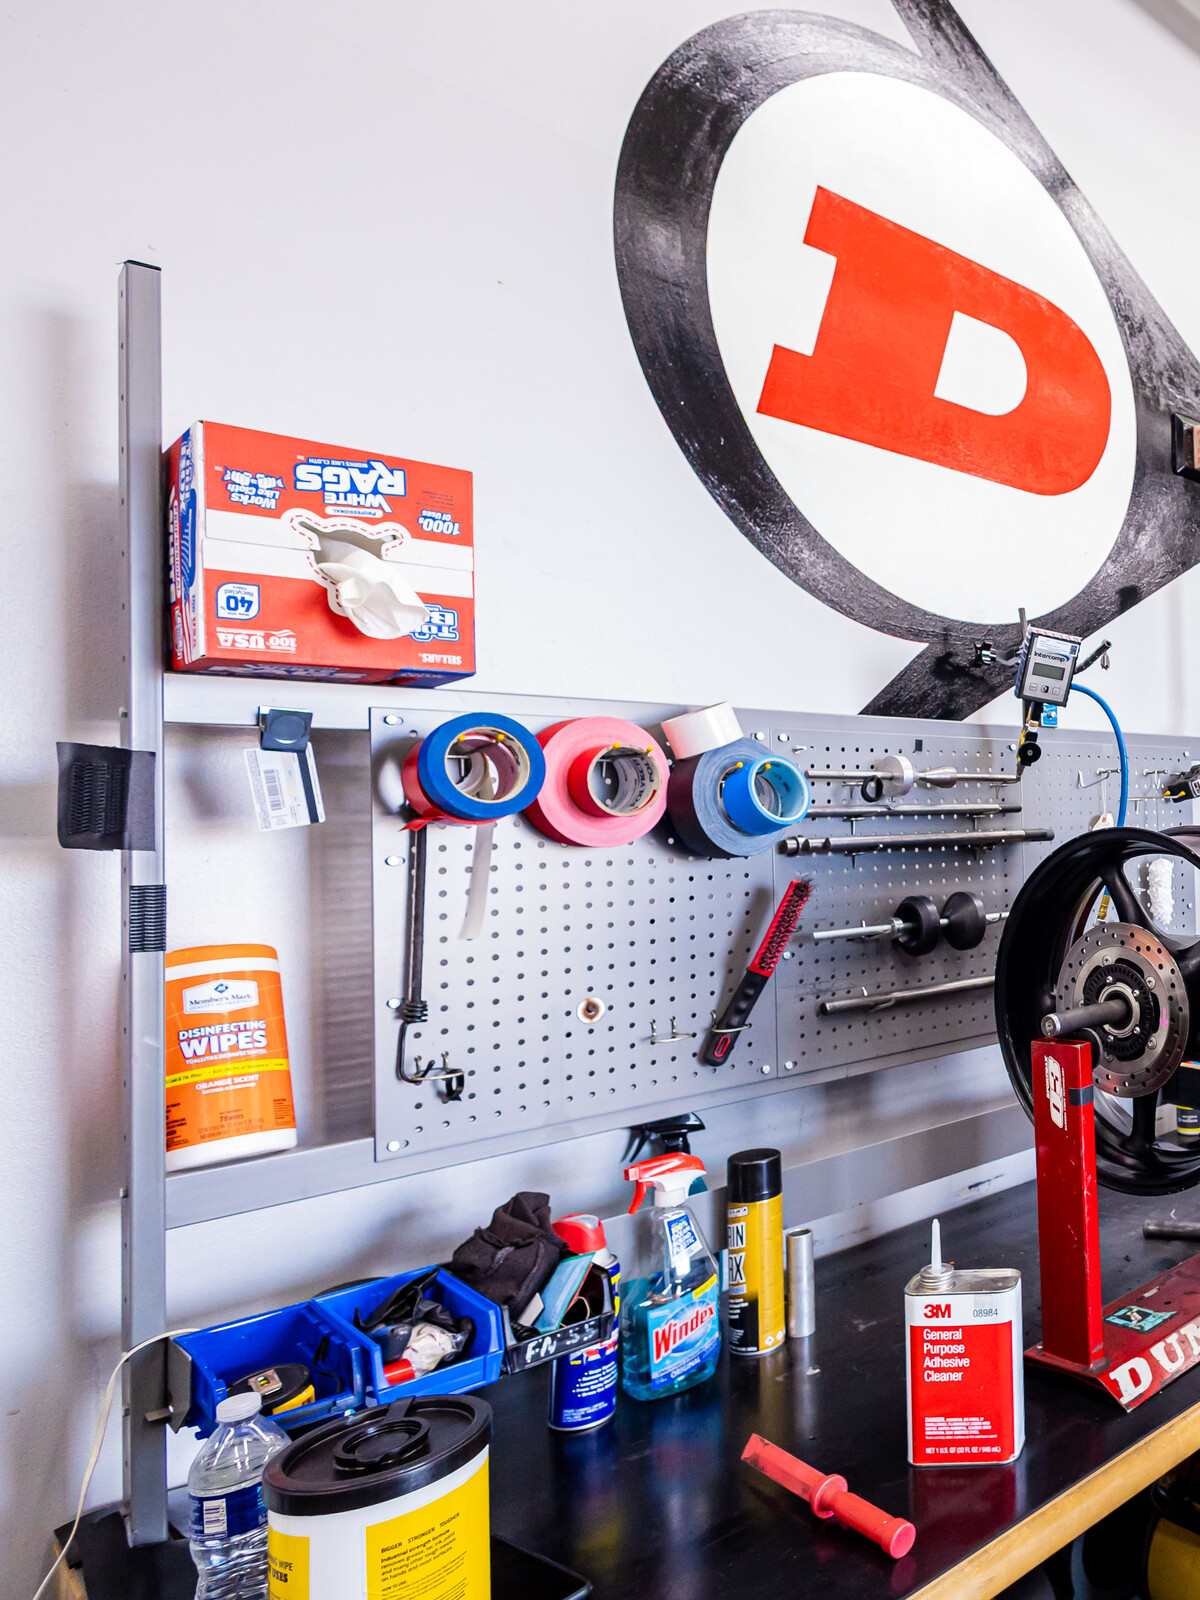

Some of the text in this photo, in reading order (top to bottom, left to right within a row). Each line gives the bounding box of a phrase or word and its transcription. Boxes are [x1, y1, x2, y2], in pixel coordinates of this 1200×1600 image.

[756, 185, 1111, 496] D
[295, 460, 405, 496] RAGS
[227, 483, 280, 499] Like Cloth
[230, 492, 276, 510] Works
[324, 492, 393, 513] WHITE
[422, 510, 441, 519] Uses
[418, 517, 460, 536] 1000s
[217, 633, 265, 649] USA
[421, 653, 462, 665] SELLARS
[1034, 651, 1066, 662] Intercomp
[178, 1020, 266, 1040] DISINFECTING
[179, 1030, 267, 1058] WIPES
[195, 1077, 233, 1090] ORANGE
[233, 1074, 259, 1084] SCENT
[923, 1304, 998, 1319] 3M 08984
[654, 1305, 715, 1361] Windex
[923, 1328, 962, 1340] General
[923, 1342, 965, 1356] Purpose
[670, 1356, 701, 1379] ORIGINAL
[923, 1356, 970, 1368] Adhesive
[924, 1370, 964, 1382] Cleaner
[381, 1512, 460, 1553] BIGGER STRONGER TOUGHER
[381, 1549, 408, 1563] Industrial
[409, 1540, 431, 1552] strength
[381, 1558, 405, 1569] removes
[381, 1568, 392, 1576] and
[393, 1563, 409, 1572] many
[389, 1570, 407, 1579] hands
[408, 1564, 418, 1572] and
